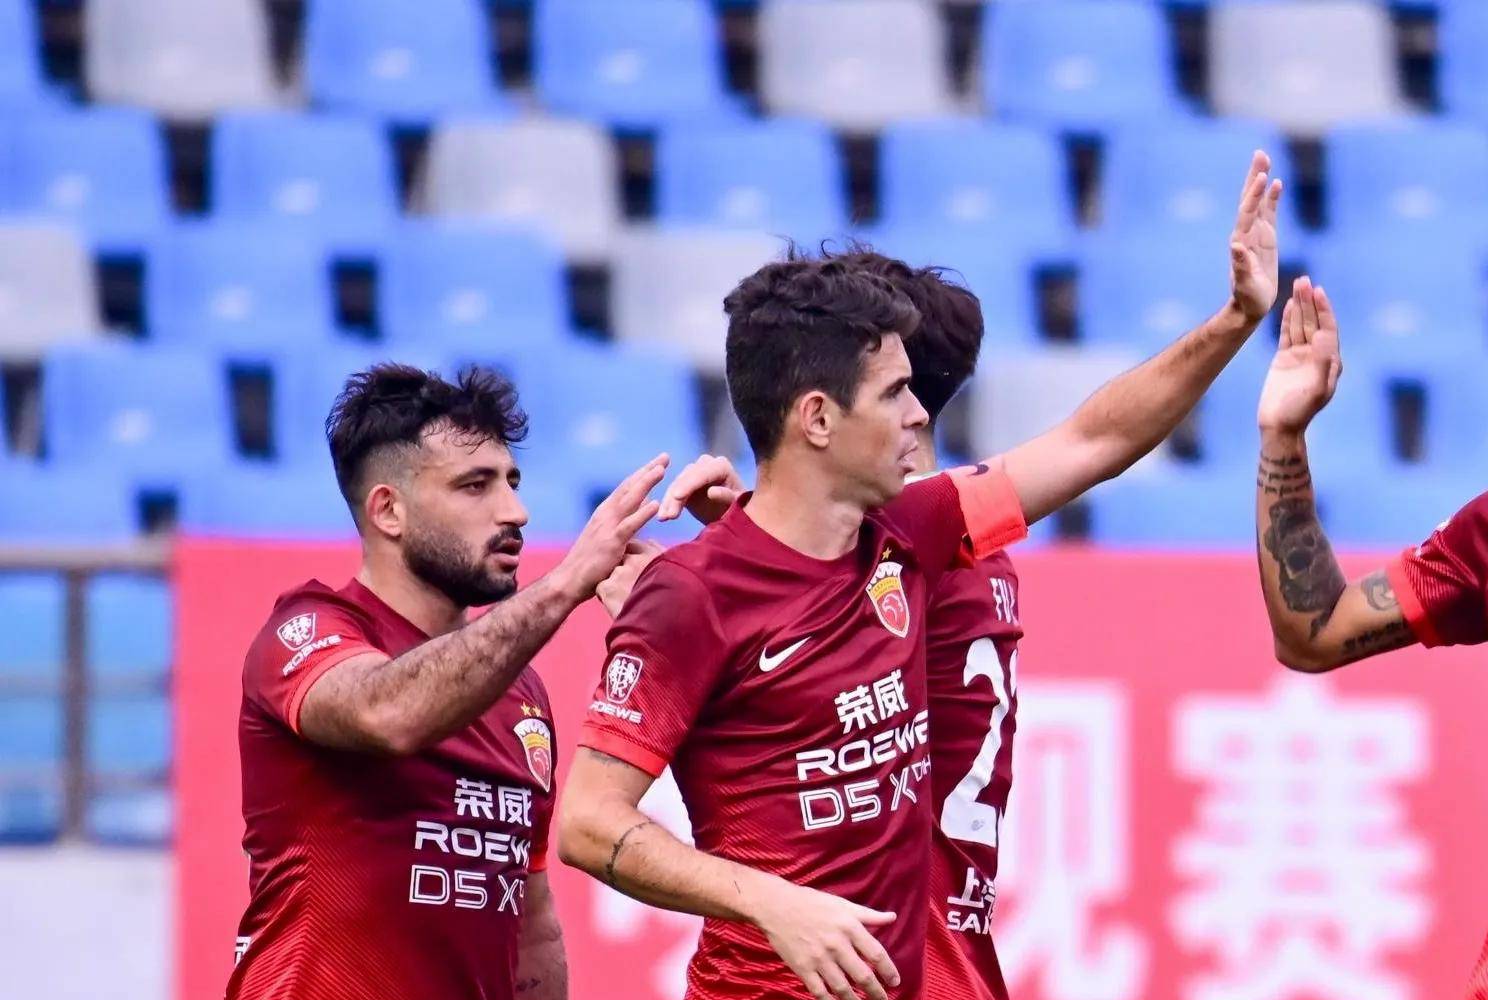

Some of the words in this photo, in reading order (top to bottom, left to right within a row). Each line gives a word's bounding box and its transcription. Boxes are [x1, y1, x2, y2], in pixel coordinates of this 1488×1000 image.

[282, 634, 342, 677] ROEWE
[834, 669, 910, 735] 荣威
[796, 709, 929, 782] ROEWE
[940, 637, 1018, 848] 2
[454, 777, 532, 828] 荣威
[414, 820, 532, 869] ROEW
